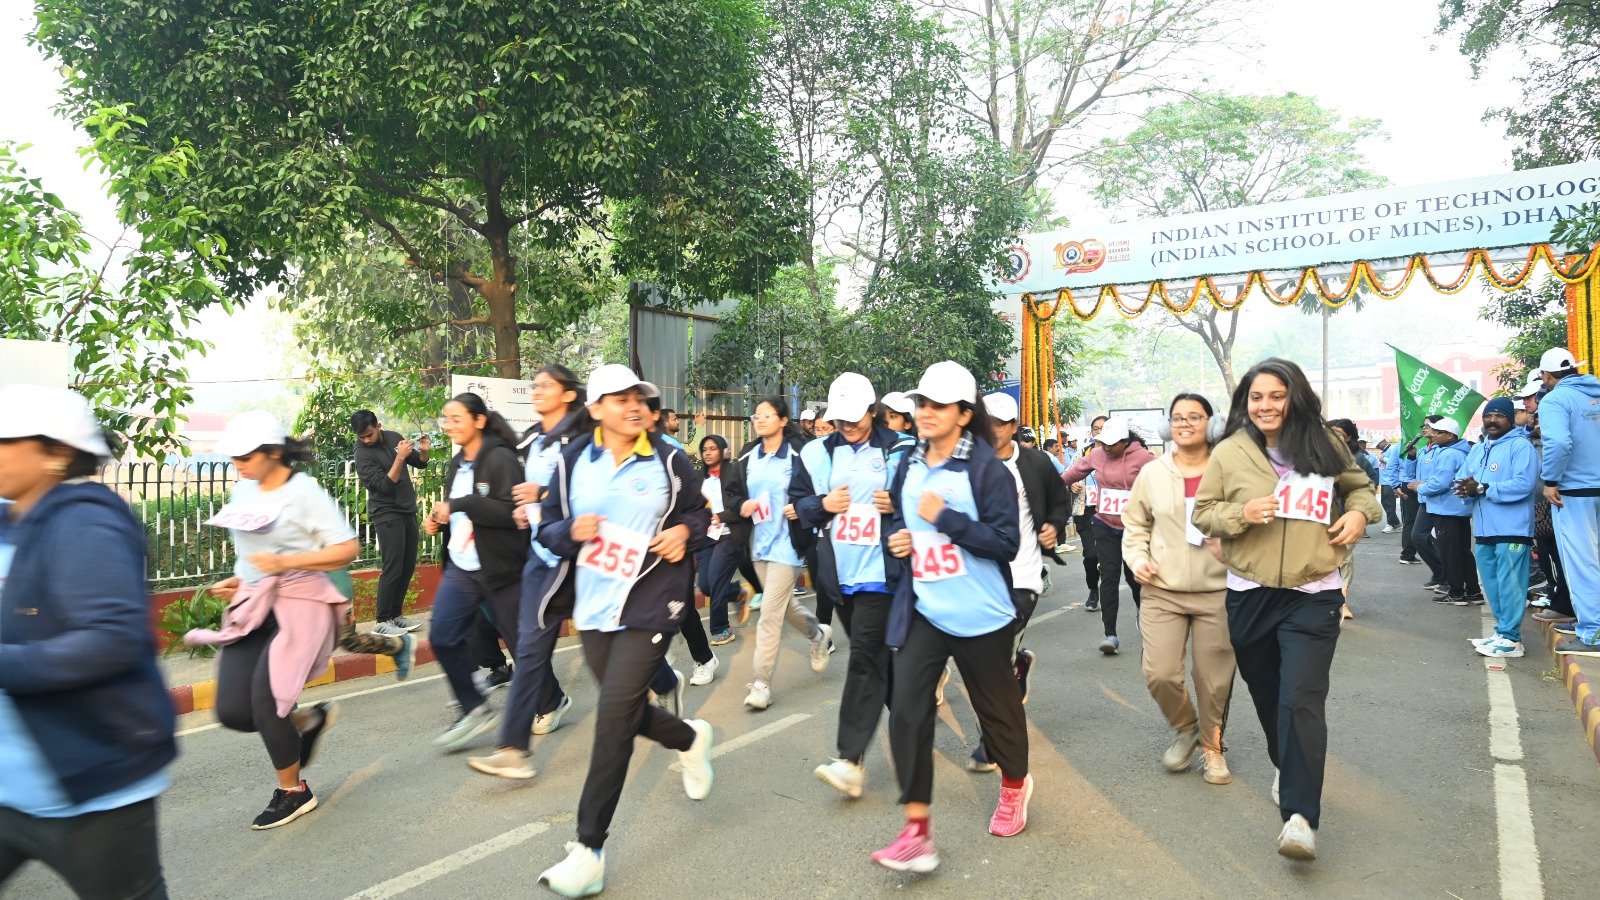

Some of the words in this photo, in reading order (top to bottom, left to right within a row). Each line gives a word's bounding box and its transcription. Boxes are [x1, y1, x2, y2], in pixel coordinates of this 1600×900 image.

[1151, 222, 1230, 244] INDIAN
[1237, 206, 1366, 234] INSTITUTE
[1374, 201, 1408, 218] OF
[1416, 177, 1600, 213] TECHNOLOG
[1151, 242, 1238, 267] (INDIAN
[1245, 231, 1341, 254] SCHOOL
[1348, 226, 1381, 243] OF
[1390, 215, 1492, 239] MINES),
[1279, 485, 1329, 520] 145
[836, 515, 876, 541] 254
[585, 535, 640, 578] 255
